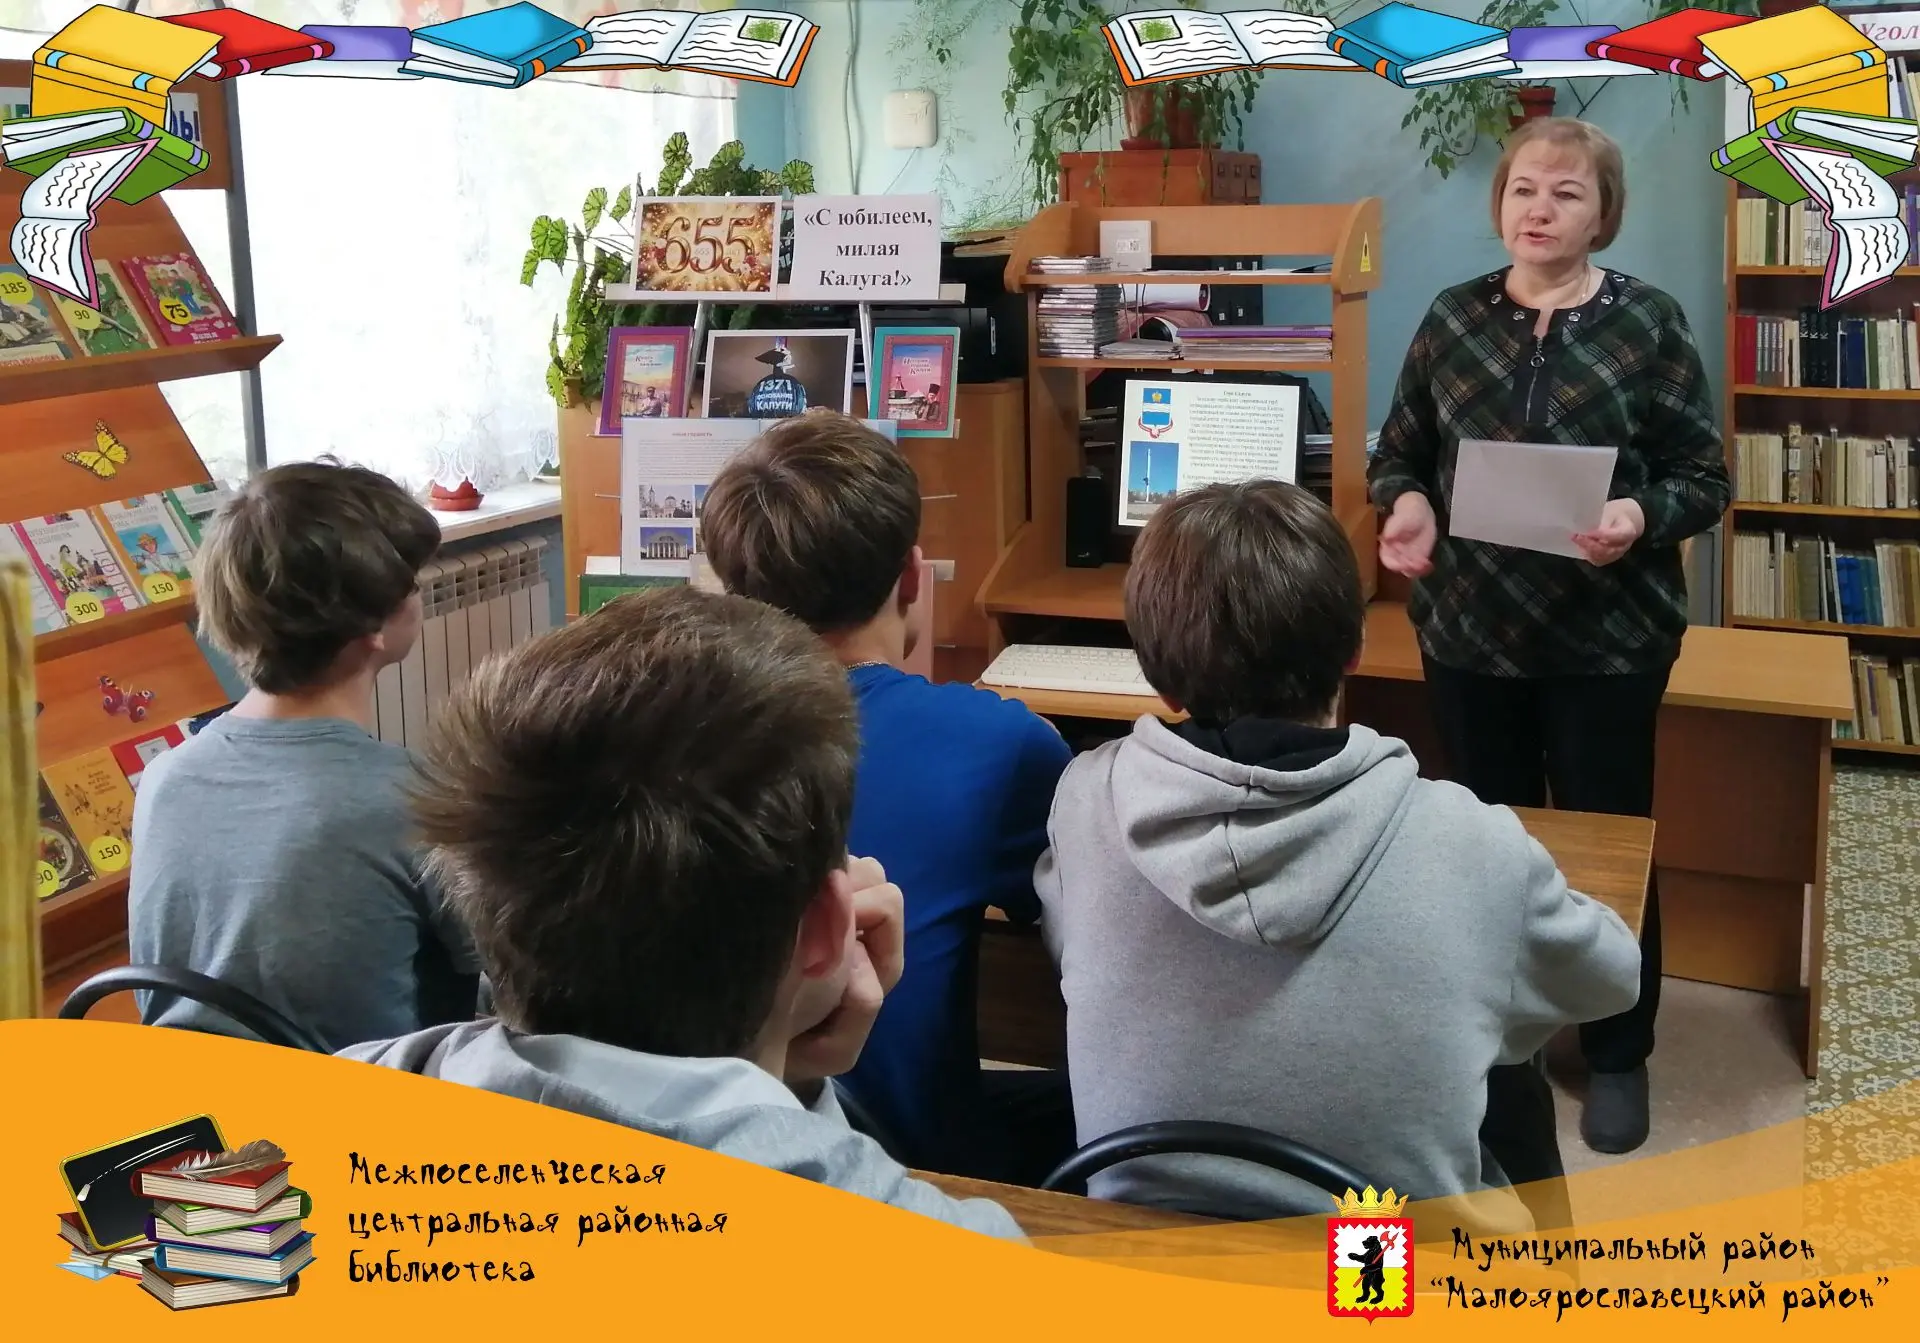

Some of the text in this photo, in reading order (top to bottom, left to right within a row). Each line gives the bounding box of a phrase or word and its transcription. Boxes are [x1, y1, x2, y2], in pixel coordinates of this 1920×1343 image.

[804, 208, 932, 227] «С юбилеем,
[656, 216, 756, 274] 655
[836, 243, 899, 257] милая
[819, 269, 912, 290] Калуга!»
[1, 281, 27, 294] 185
[73, 309, 90, 321] 90
[164, 303, 189, 319] 75
[759, 379, 792, 392] 1371
[152, 582, 174, 595] 150
[74, 601, 98, 616] 300
[98, 844, 121, 860] 150
